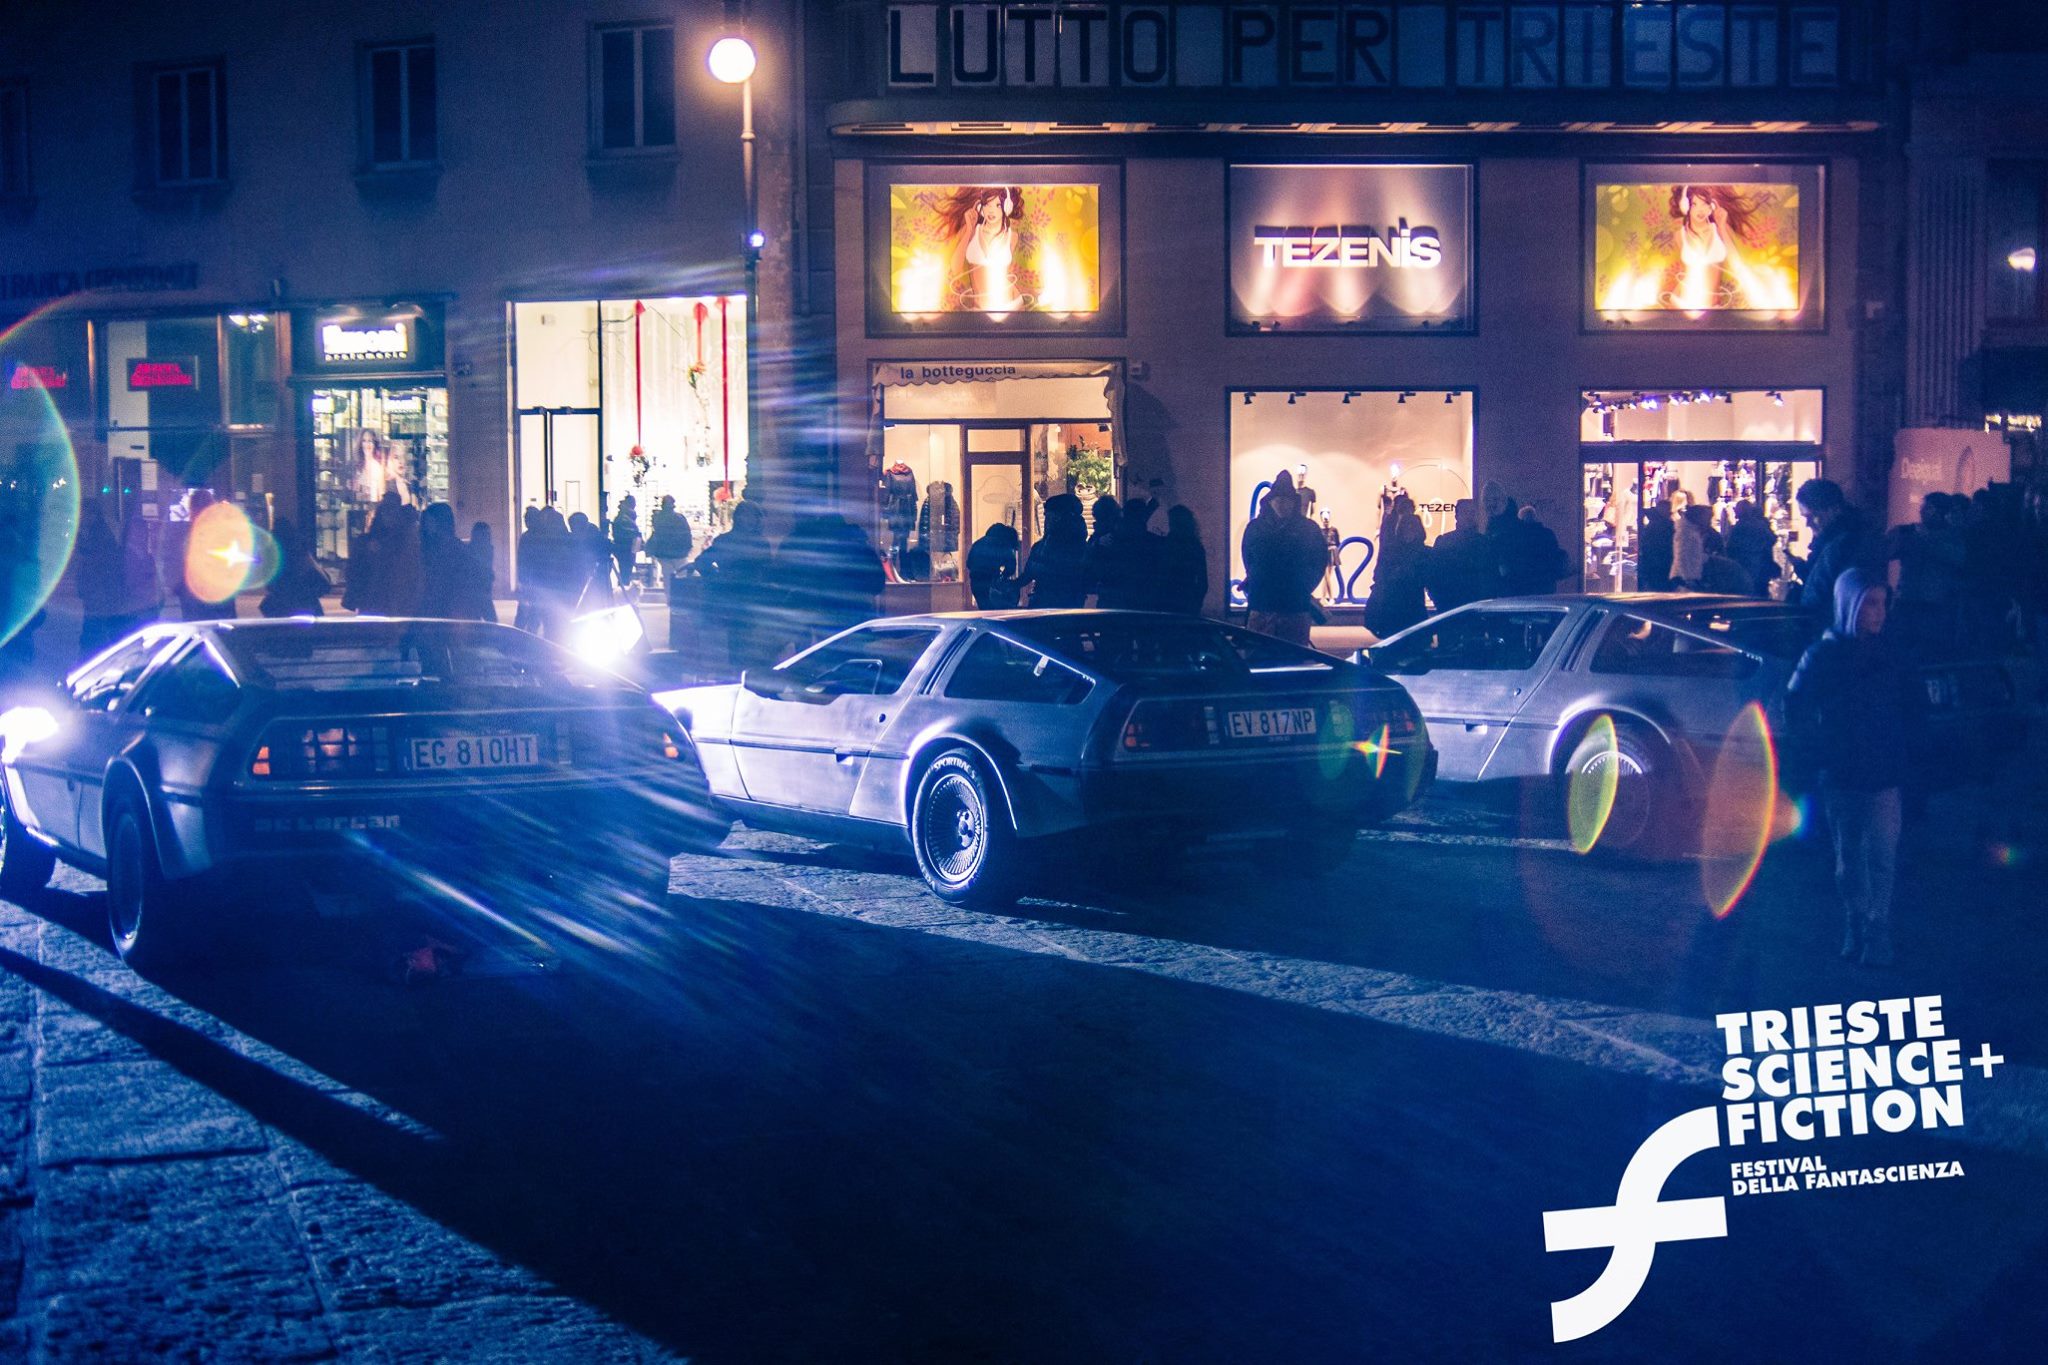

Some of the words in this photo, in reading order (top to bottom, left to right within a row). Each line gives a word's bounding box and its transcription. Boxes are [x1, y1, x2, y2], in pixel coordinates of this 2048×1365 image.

[891, 9, 1168, 83] LUTTO
[1233, 9, 1389, 83] PER
[1457, 9, 1836, 83] TRIESTE
[900, 366, 914, 379] la
[922, 365, 1016, 379] botteguccia
[1419, 503, 1457, 513] TEZEN
[1232, 712, 1253, 736] EV
[1260, 710, 1313, 735] 817NP
[414, 740, 447, 768] EG
[457, 737, 532, 766] 810HT
